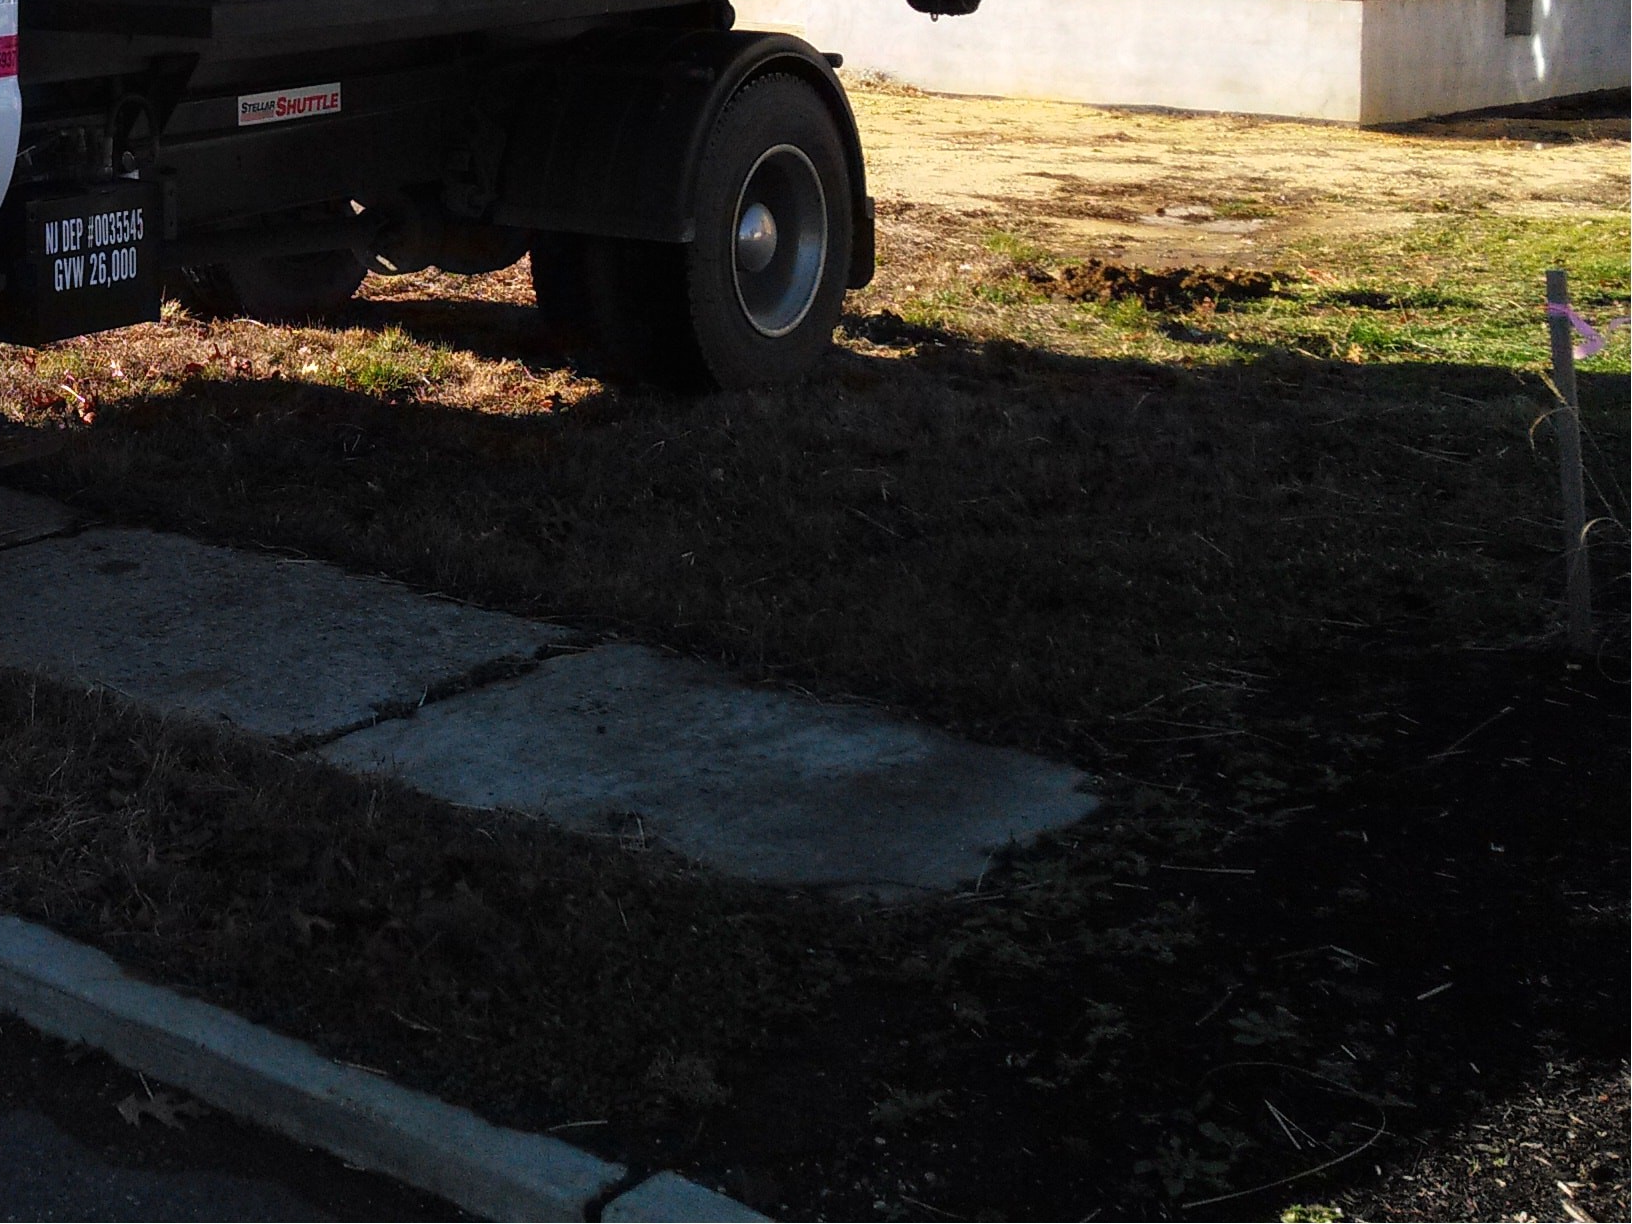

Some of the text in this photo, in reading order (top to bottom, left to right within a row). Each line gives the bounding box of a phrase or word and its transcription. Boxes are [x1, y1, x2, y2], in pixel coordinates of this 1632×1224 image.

[241, 92, 339, 117] STELLAR SHUTTLE
[45, 208, 144, 255] NJ DEP #0035545
[54, 246, 137, 292] GVW 26,000
